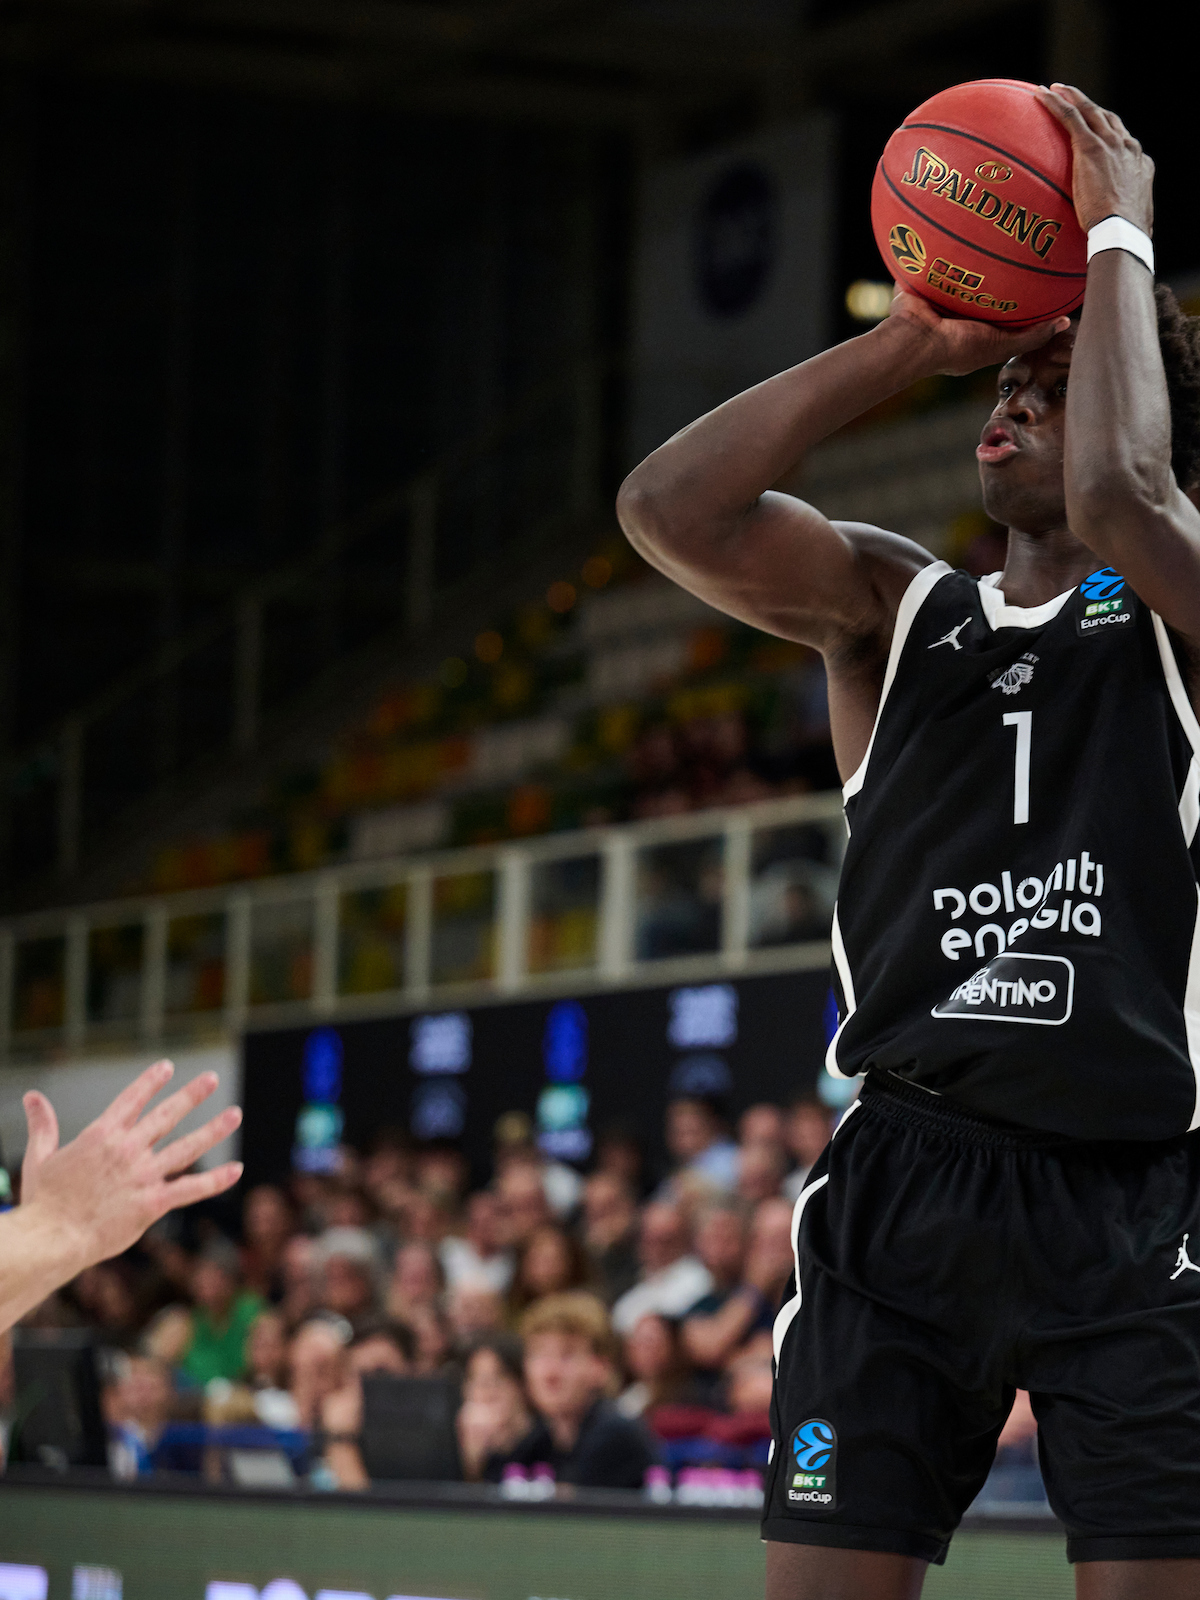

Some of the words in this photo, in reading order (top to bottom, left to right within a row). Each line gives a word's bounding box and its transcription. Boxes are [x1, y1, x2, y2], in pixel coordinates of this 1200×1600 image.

[903, 147, 1062, 258] SPALDING
[928, 270, 1018, 312] EuroCup
[1086, 600, 1122, 615] BKT
[1081, 613, 1130, 629] EuroCup
[1003, 711, 1032, 824] 1
[793, 1475, 825, 1487] BKT
[788, 1489, 832, 1504] EuroCup
